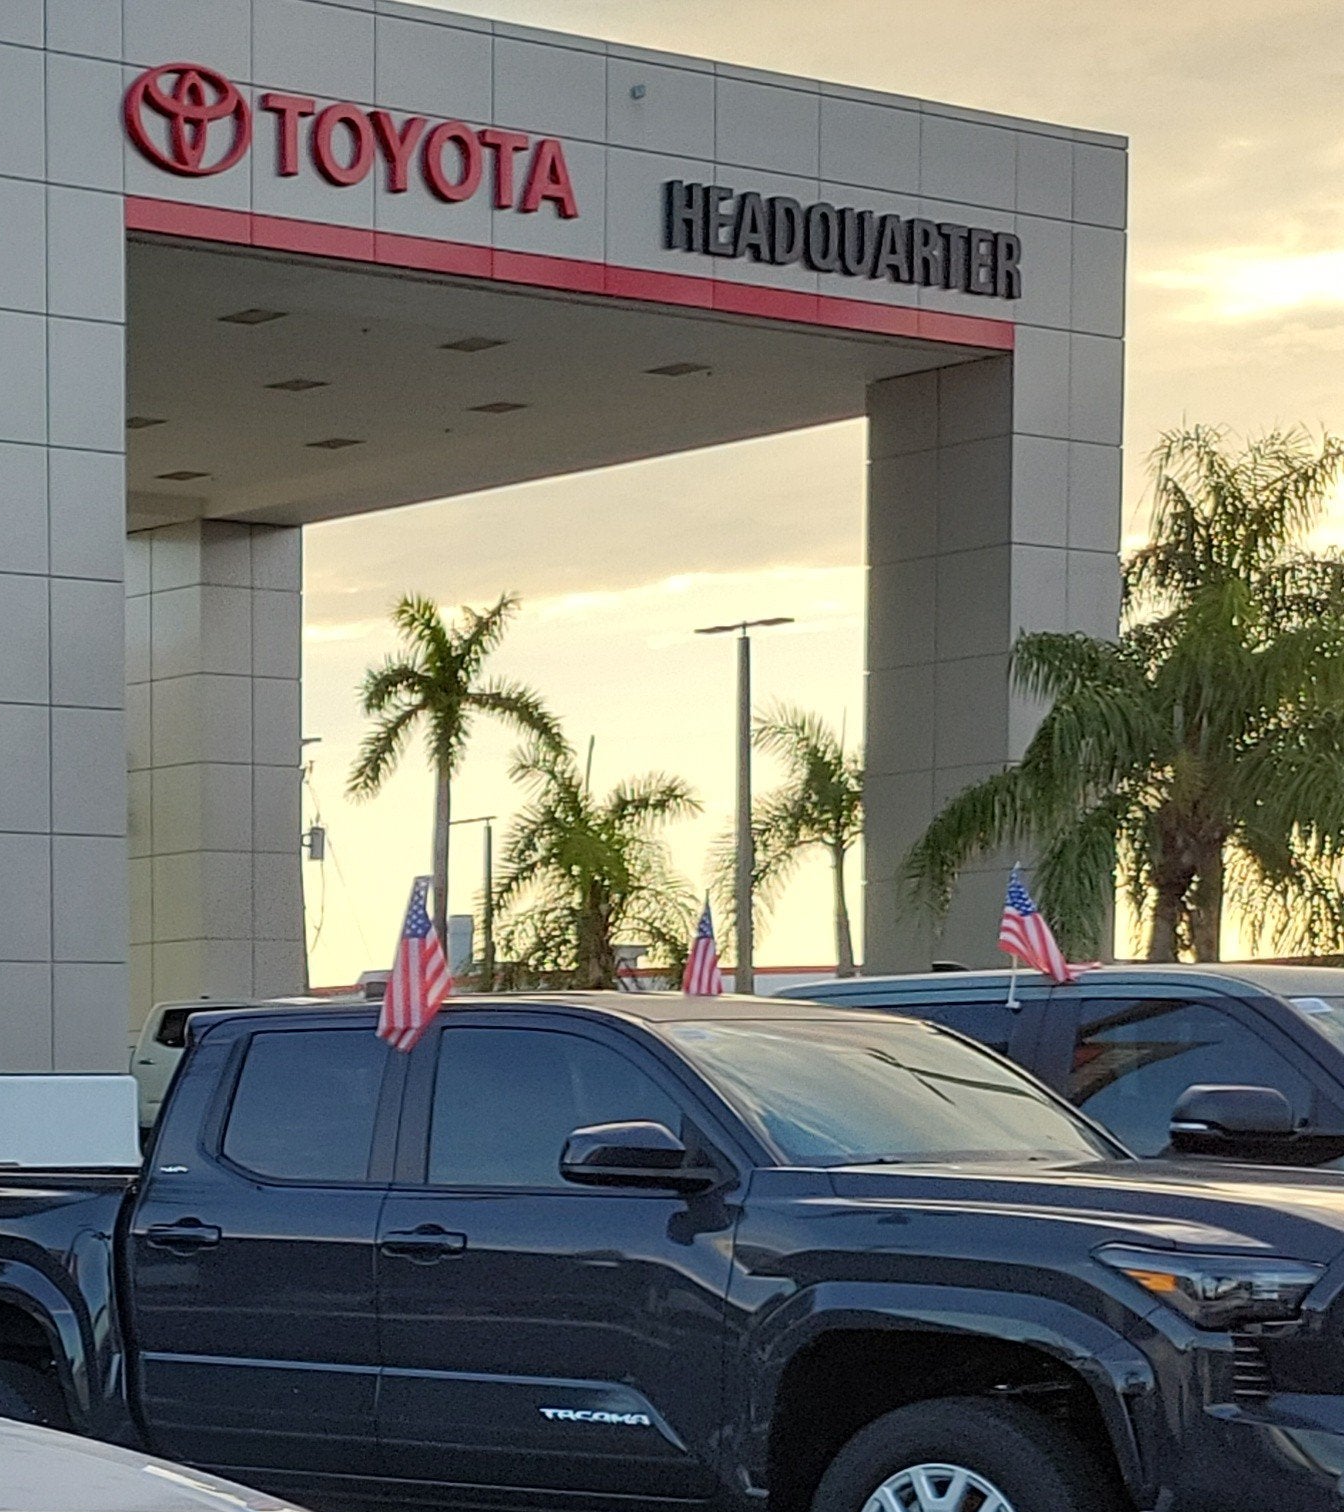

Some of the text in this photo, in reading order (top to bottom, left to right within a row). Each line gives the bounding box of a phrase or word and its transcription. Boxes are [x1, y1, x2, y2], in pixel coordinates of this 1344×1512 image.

[262, 92, 1022, 300] TOYOTA HEADQUARTER
[539, 1407, 651, 1427] TACOMA
